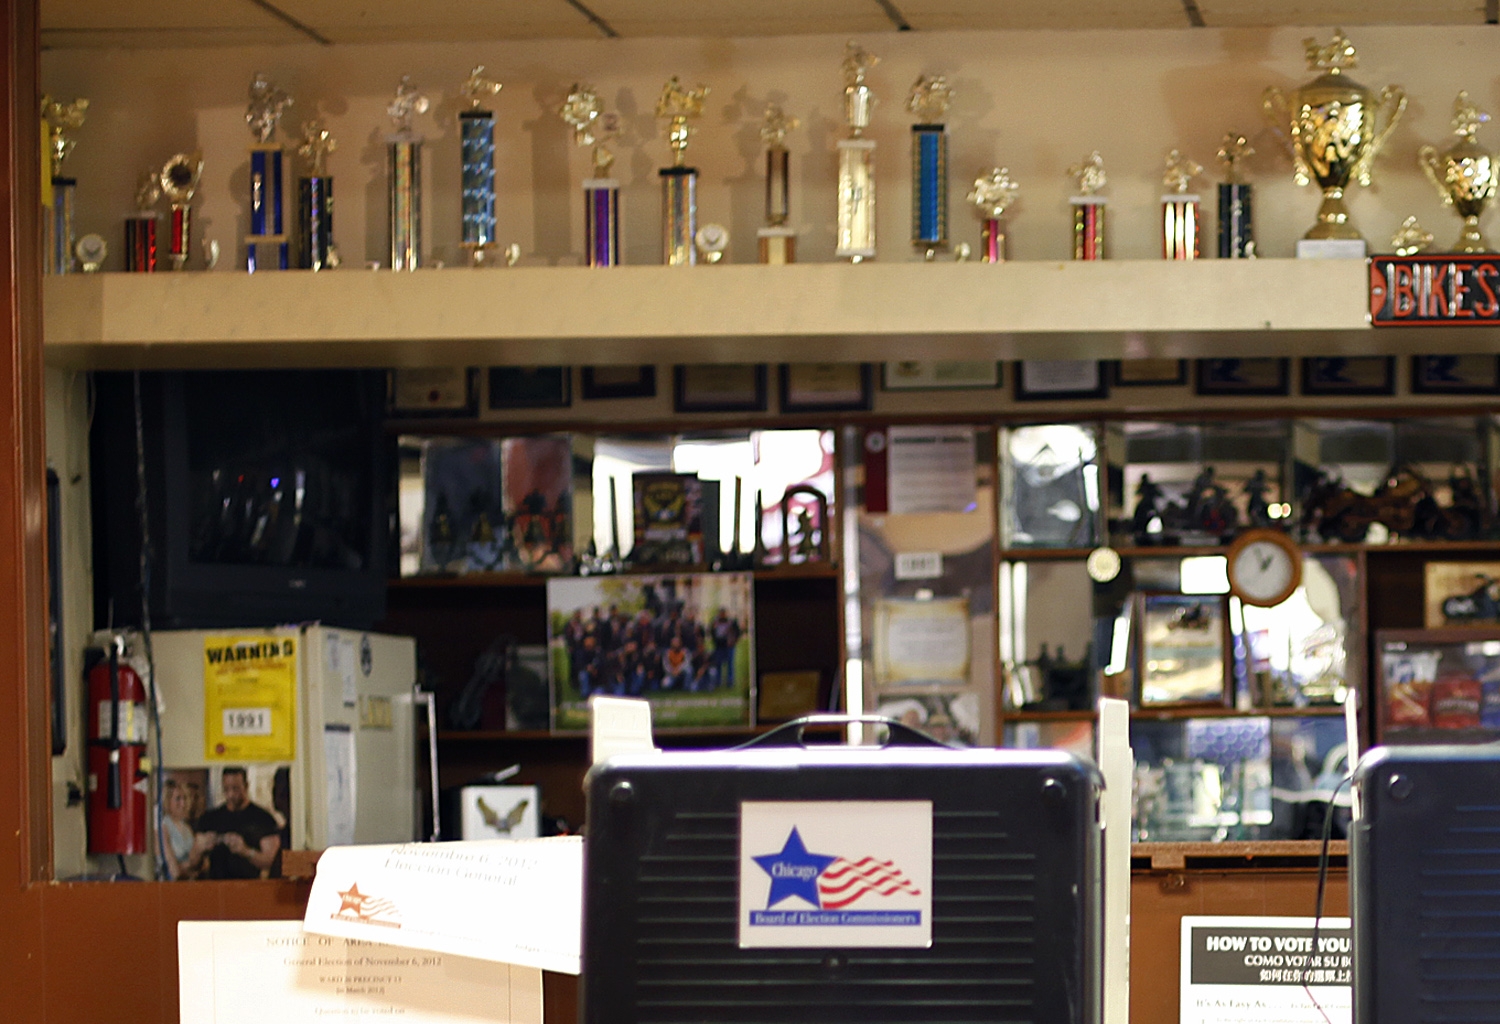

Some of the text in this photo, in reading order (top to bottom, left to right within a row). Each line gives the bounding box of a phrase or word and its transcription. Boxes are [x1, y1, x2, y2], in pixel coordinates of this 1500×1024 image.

[206, 639, 294, 664] WARNING
[228, 713, 265, 729] 1991
[771, 862, 818, 882] Chicago
[755, 913, 916, 924] Board of Election Commissioners
[318, 937, 333, 947] OF
[1206, 936, 1248, 952] HOW
[1249, 936, 1272, 951] TO
[1274, 937, 1314, 952] VOTE
[283, 957, 317, 968] General
[318, 957, 352, 968] Election
[365, 957, 410, 968] November
[421, 957, 442, 967] 2012
[1244, 955, 1284, 967] COMO
[1324, 956, 1339, 967] SU
